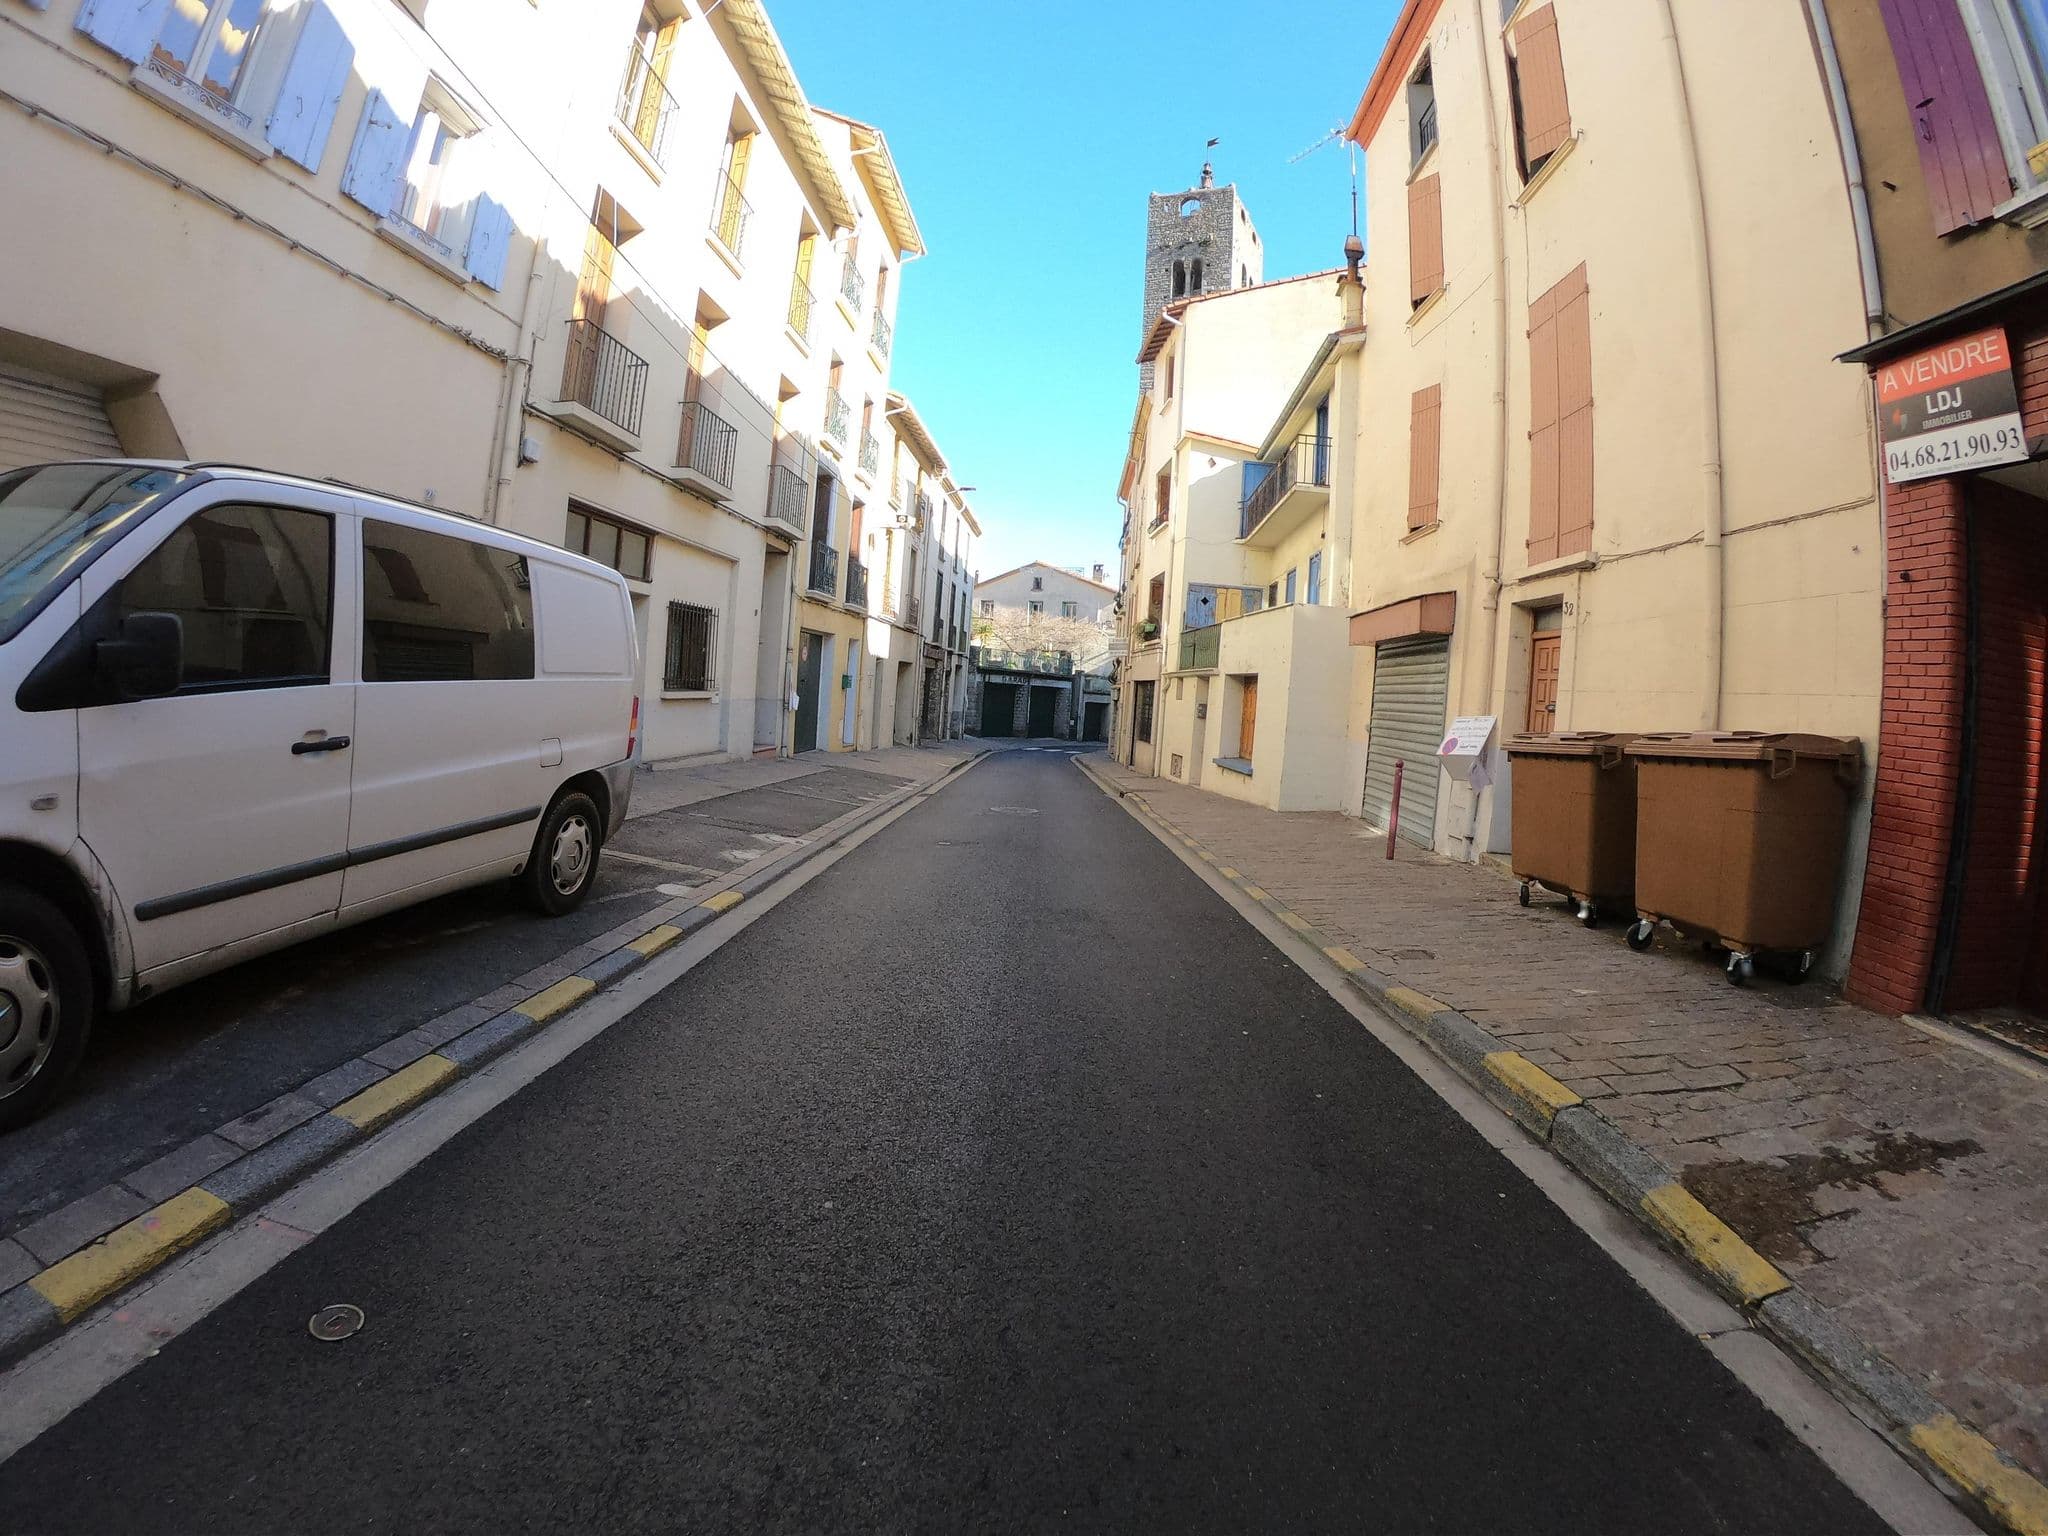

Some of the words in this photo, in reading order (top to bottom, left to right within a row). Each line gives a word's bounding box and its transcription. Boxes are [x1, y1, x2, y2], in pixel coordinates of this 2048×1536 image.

[1883, 373, 1898, 394] A
[1900, 335, 2001, 387] VENDRE
[1925, 387, 1963, 414] LDJ
[1922, 410, 1973, 430] IMMOBILIER
[1890, 428, 2021, 472] 04.68.21.90.93
[1564, 601, 1574, 616] 32
